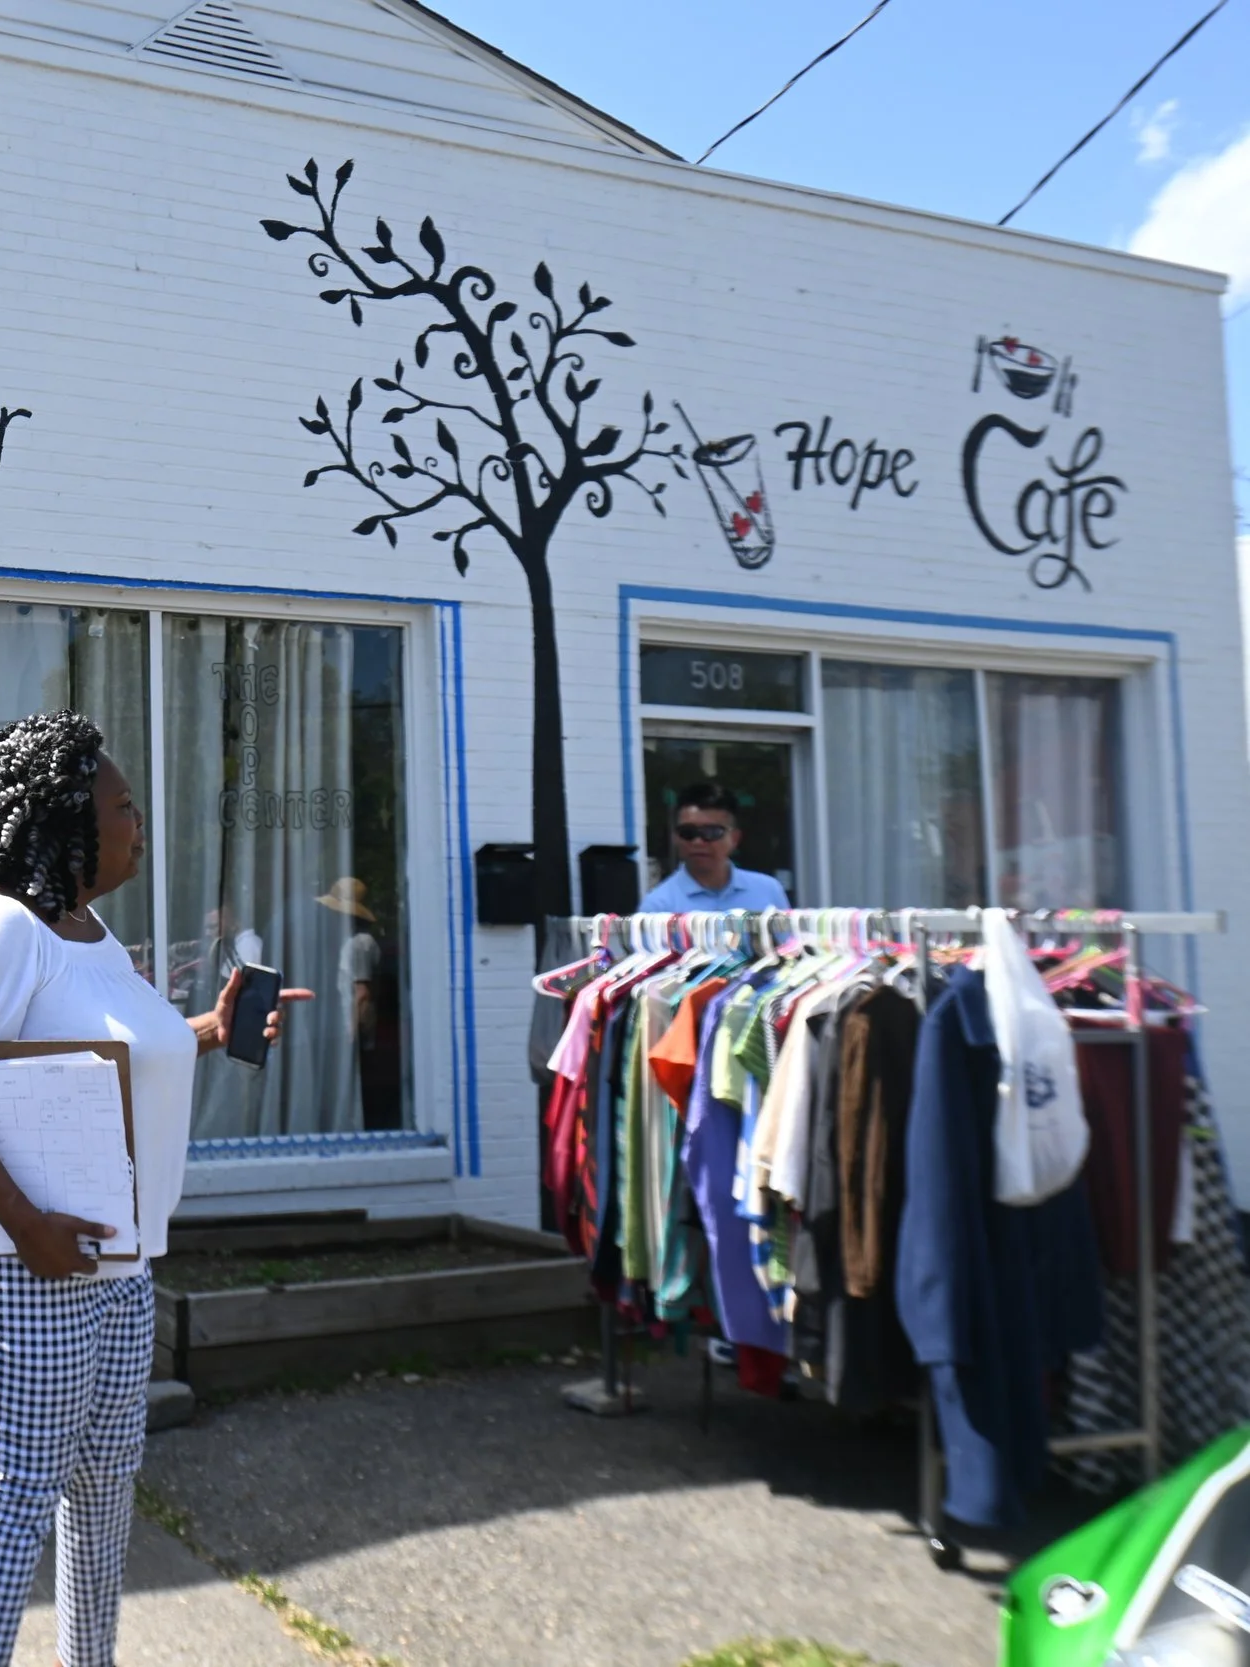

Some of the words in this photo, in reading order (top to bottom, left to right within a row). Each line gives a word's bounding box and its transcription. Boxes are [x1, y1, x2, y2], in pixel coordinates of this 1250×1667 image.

[774, 415, 919, 511] Hope
[212, 662, 280, 707] THE
[690, 660, 745, 691] 508
[218, 786, 355, 831] CENTER
